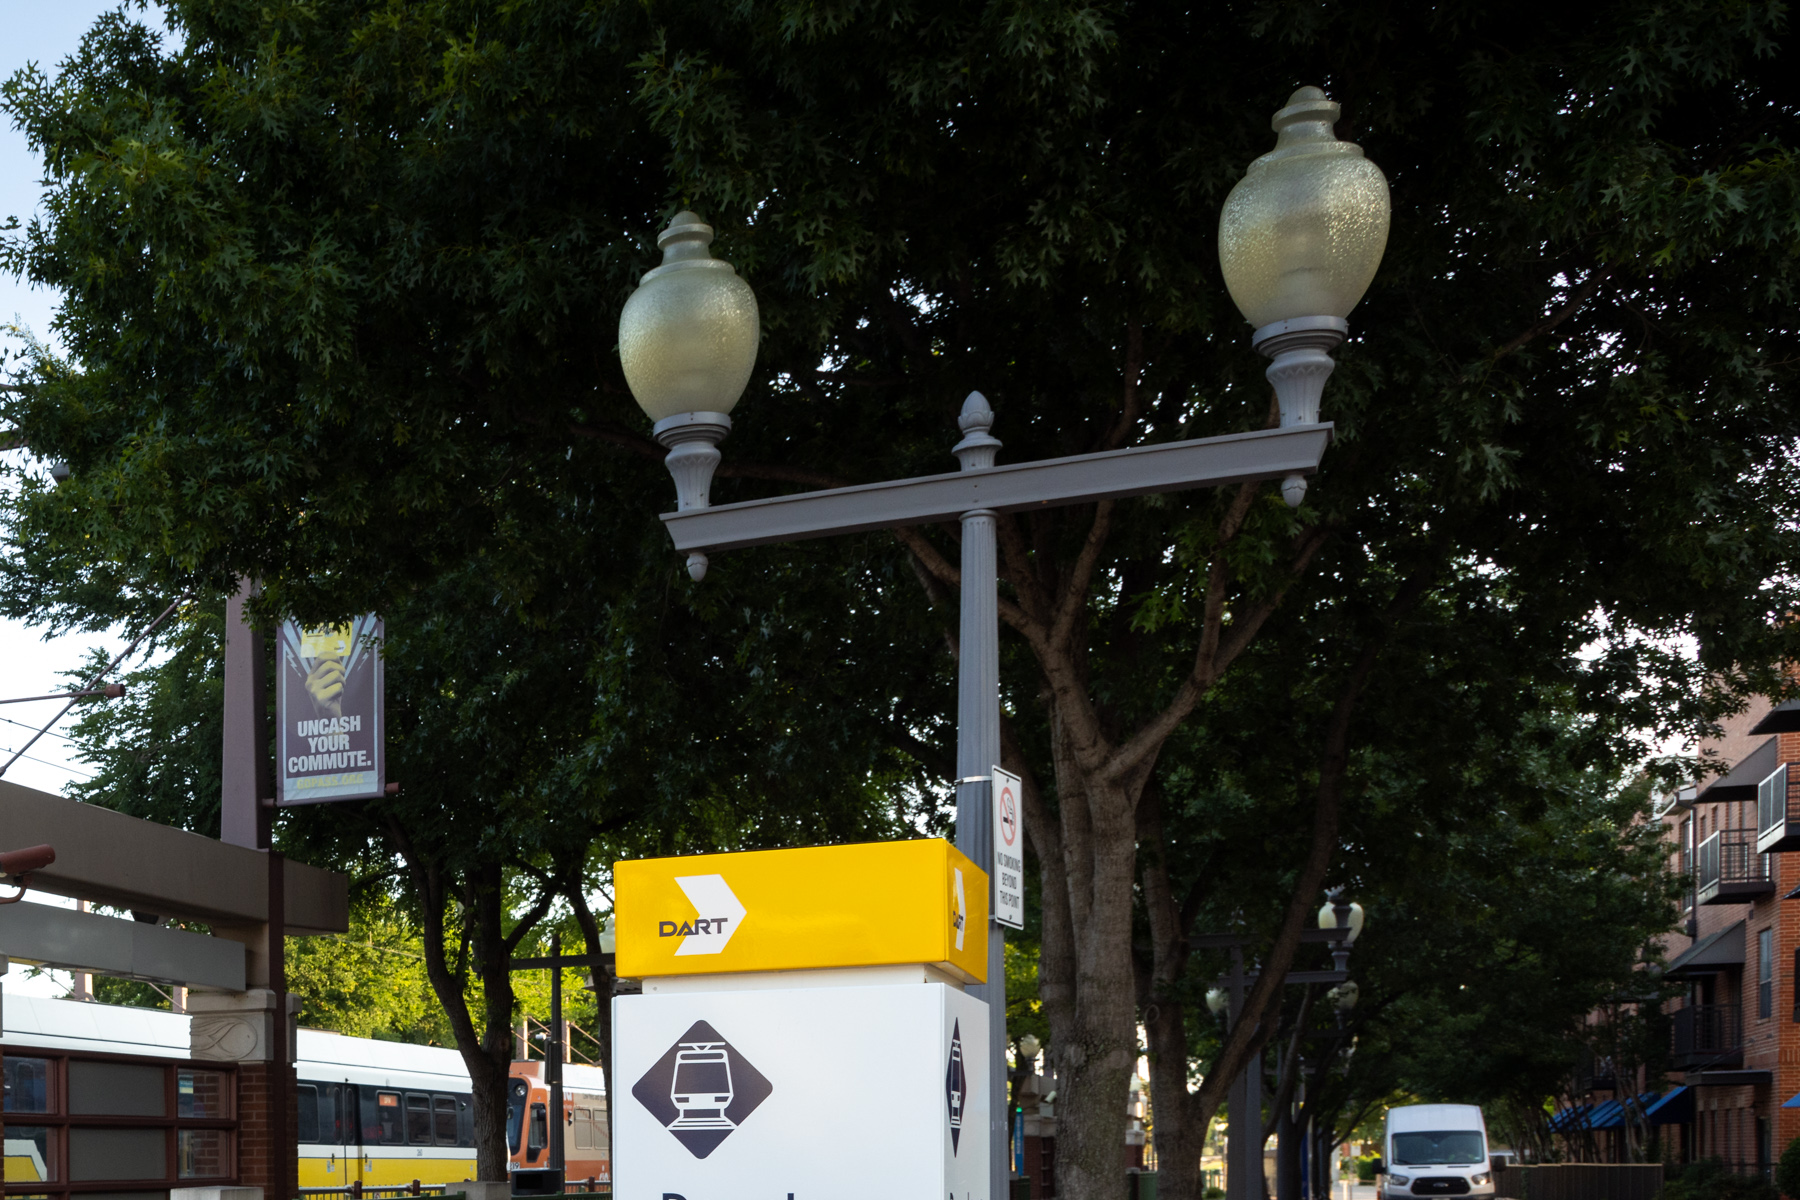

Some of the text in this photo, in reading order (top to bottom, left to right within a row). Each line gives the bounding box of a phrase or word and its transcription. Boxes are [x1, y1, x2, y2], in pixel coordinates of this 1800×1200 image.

[297, 715, 361, 737] UNCASH
[307, 734, 350, 754] YOUR
[288, 750, 372, 773] COMMUTE.
[297, 774, 363, 789] GOPASS.ORG
[997, 851, 1021, 873] NO SMOKING
[1002, 872, 1017, 890] BEYOND
[1000, 890, 1020, 910] THIS POINT
[659, 917, 728, 938] DART
